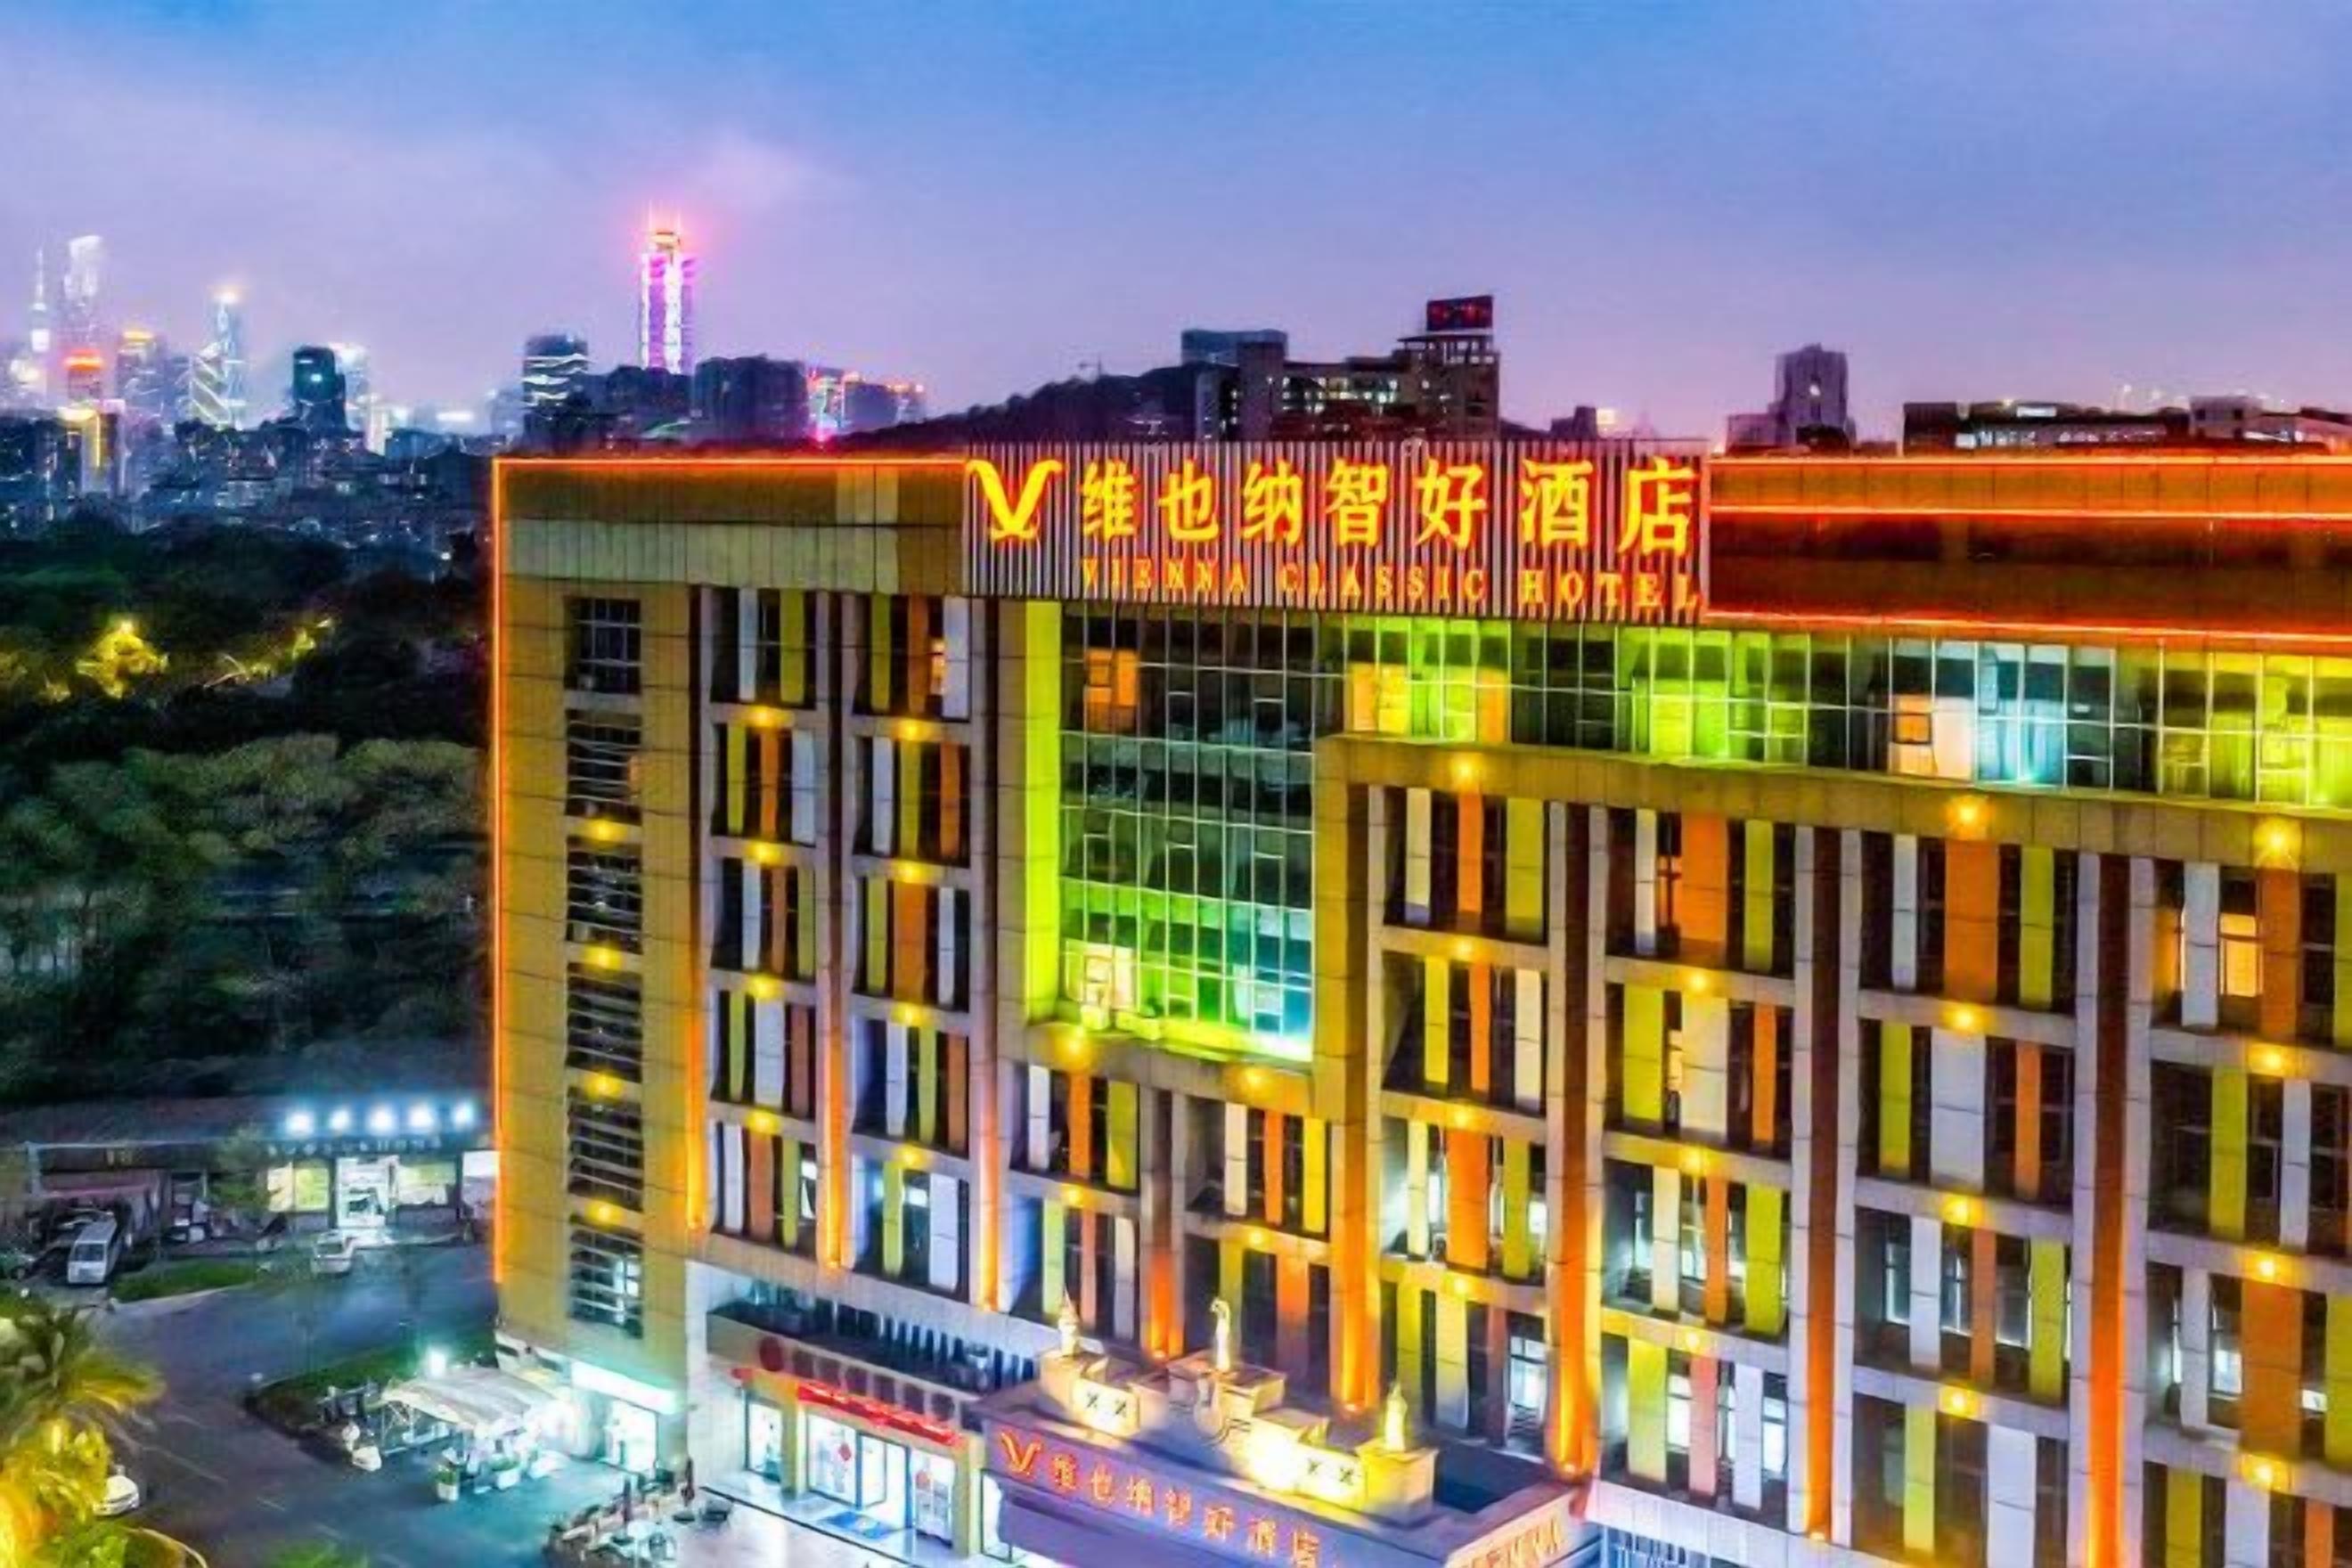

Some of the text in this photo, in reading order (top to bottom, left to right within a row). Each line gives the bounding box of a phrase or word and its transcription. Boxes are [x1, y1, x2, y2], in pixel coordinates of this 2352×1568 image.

[1082, 456, 1696, 557] 维也纳智好酒店
[1082, 558, 1702, 611] VIENNA CLASSIC HOTEL
